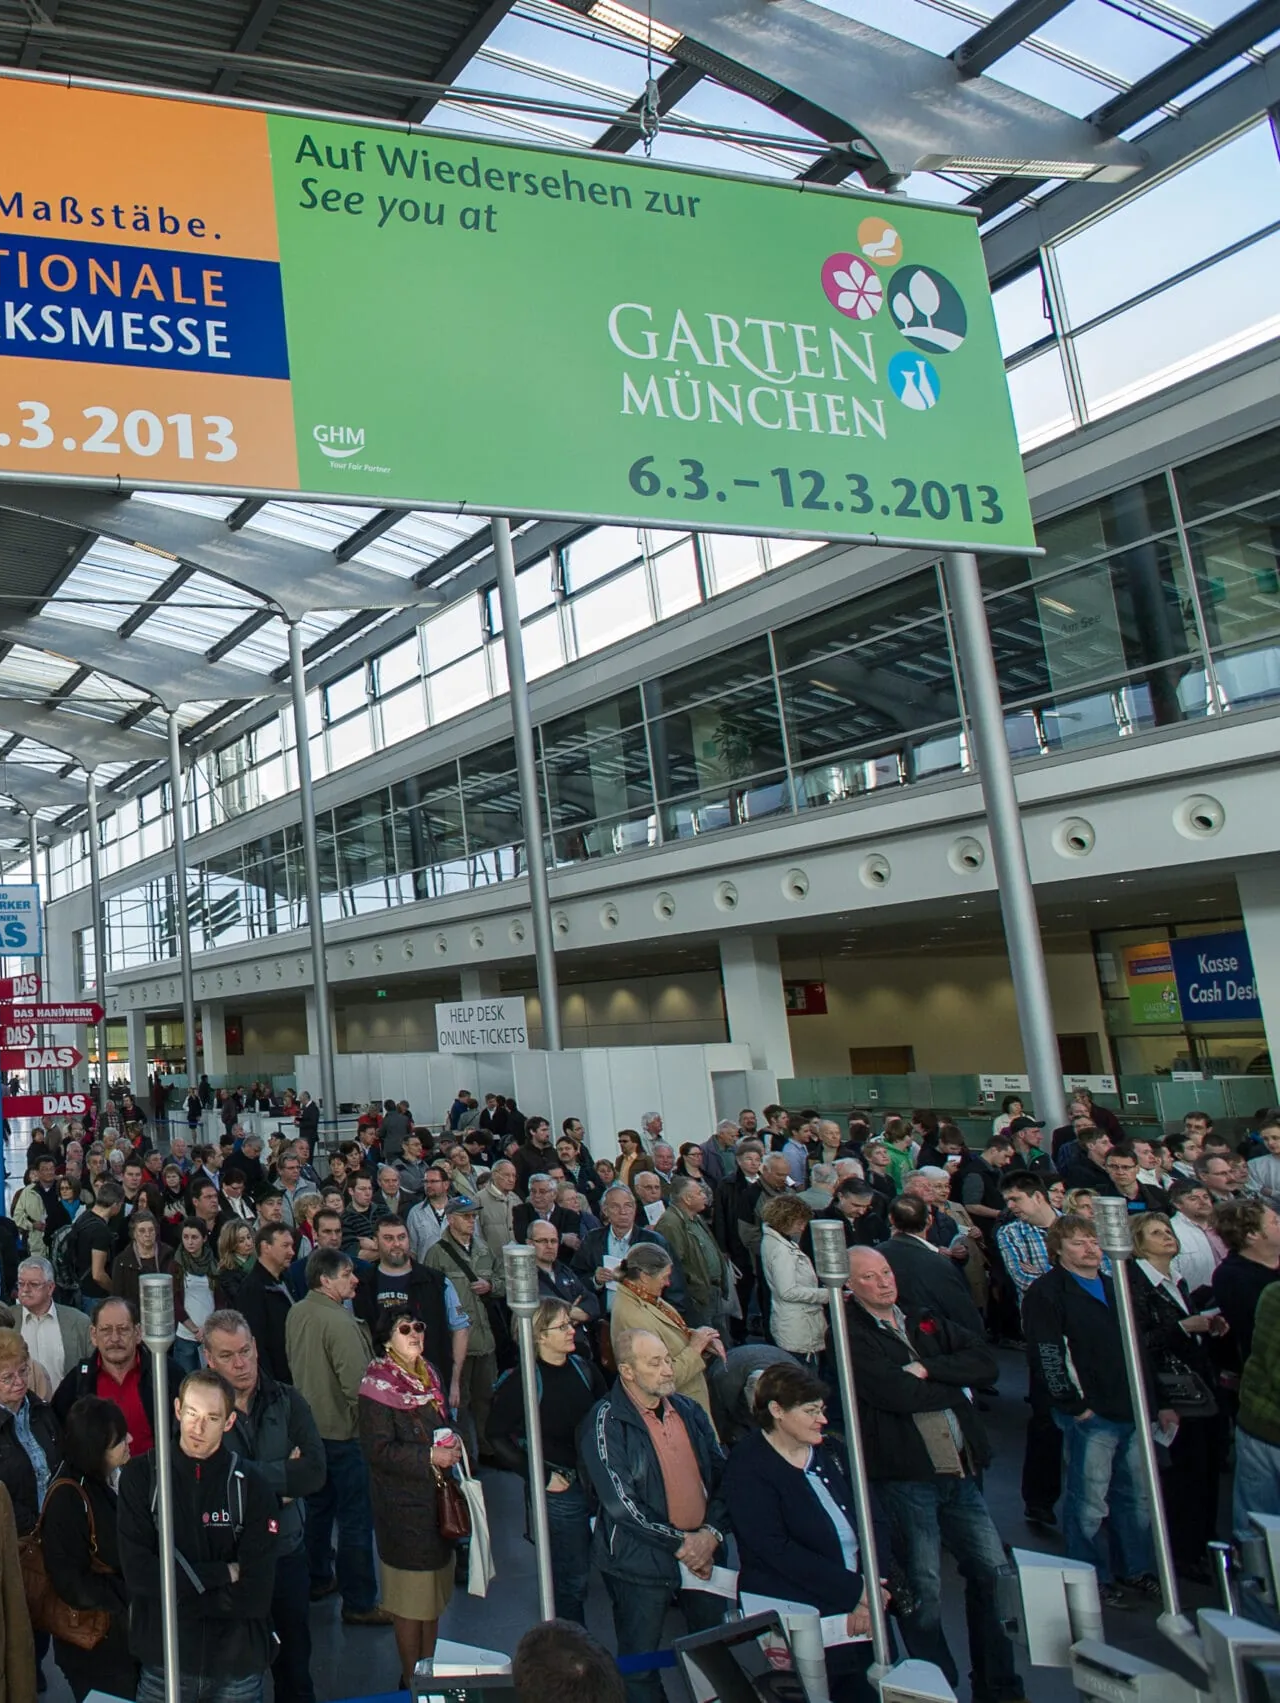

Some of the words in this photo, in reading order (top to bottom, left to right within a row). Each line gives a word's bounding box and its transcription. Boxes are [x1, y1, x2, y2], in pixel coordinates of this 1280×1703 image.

[294, 133, 367, 170] Auf
[378, 145, 634, 210] Wiedersehen
[643, 190, 701, 220] zur
[299, 176, 365, 216] See
[377, 195, 446, 230] you
[458, 202, 498, 233] at
[608, 302, 879, 385] GARTEN
[620, 369, 888, 440] MÜNCHEN
[312, 424, 365, 445] GHM
[330, 460, 347, 469] Your
[1198, 953, 1239, 974] Kasse
[12, 975, 37, 996] DAS
[1189, 981, 1222, 1003] Cash
[13, 1008, 34, 1018] DAS
[37, 1005, 92, 1017] HANDWERK
[450, 1007, 474, 1023] HELP
[477, 1005, 505, 1021] DESK
[6, 1026, 31, 1044] DAS
[440, 1028, 525, 1046] ONLINE-TICKETS
[25, 1048, 74, 1069] DAS
[43, 1094, 86, 1114] DAS
